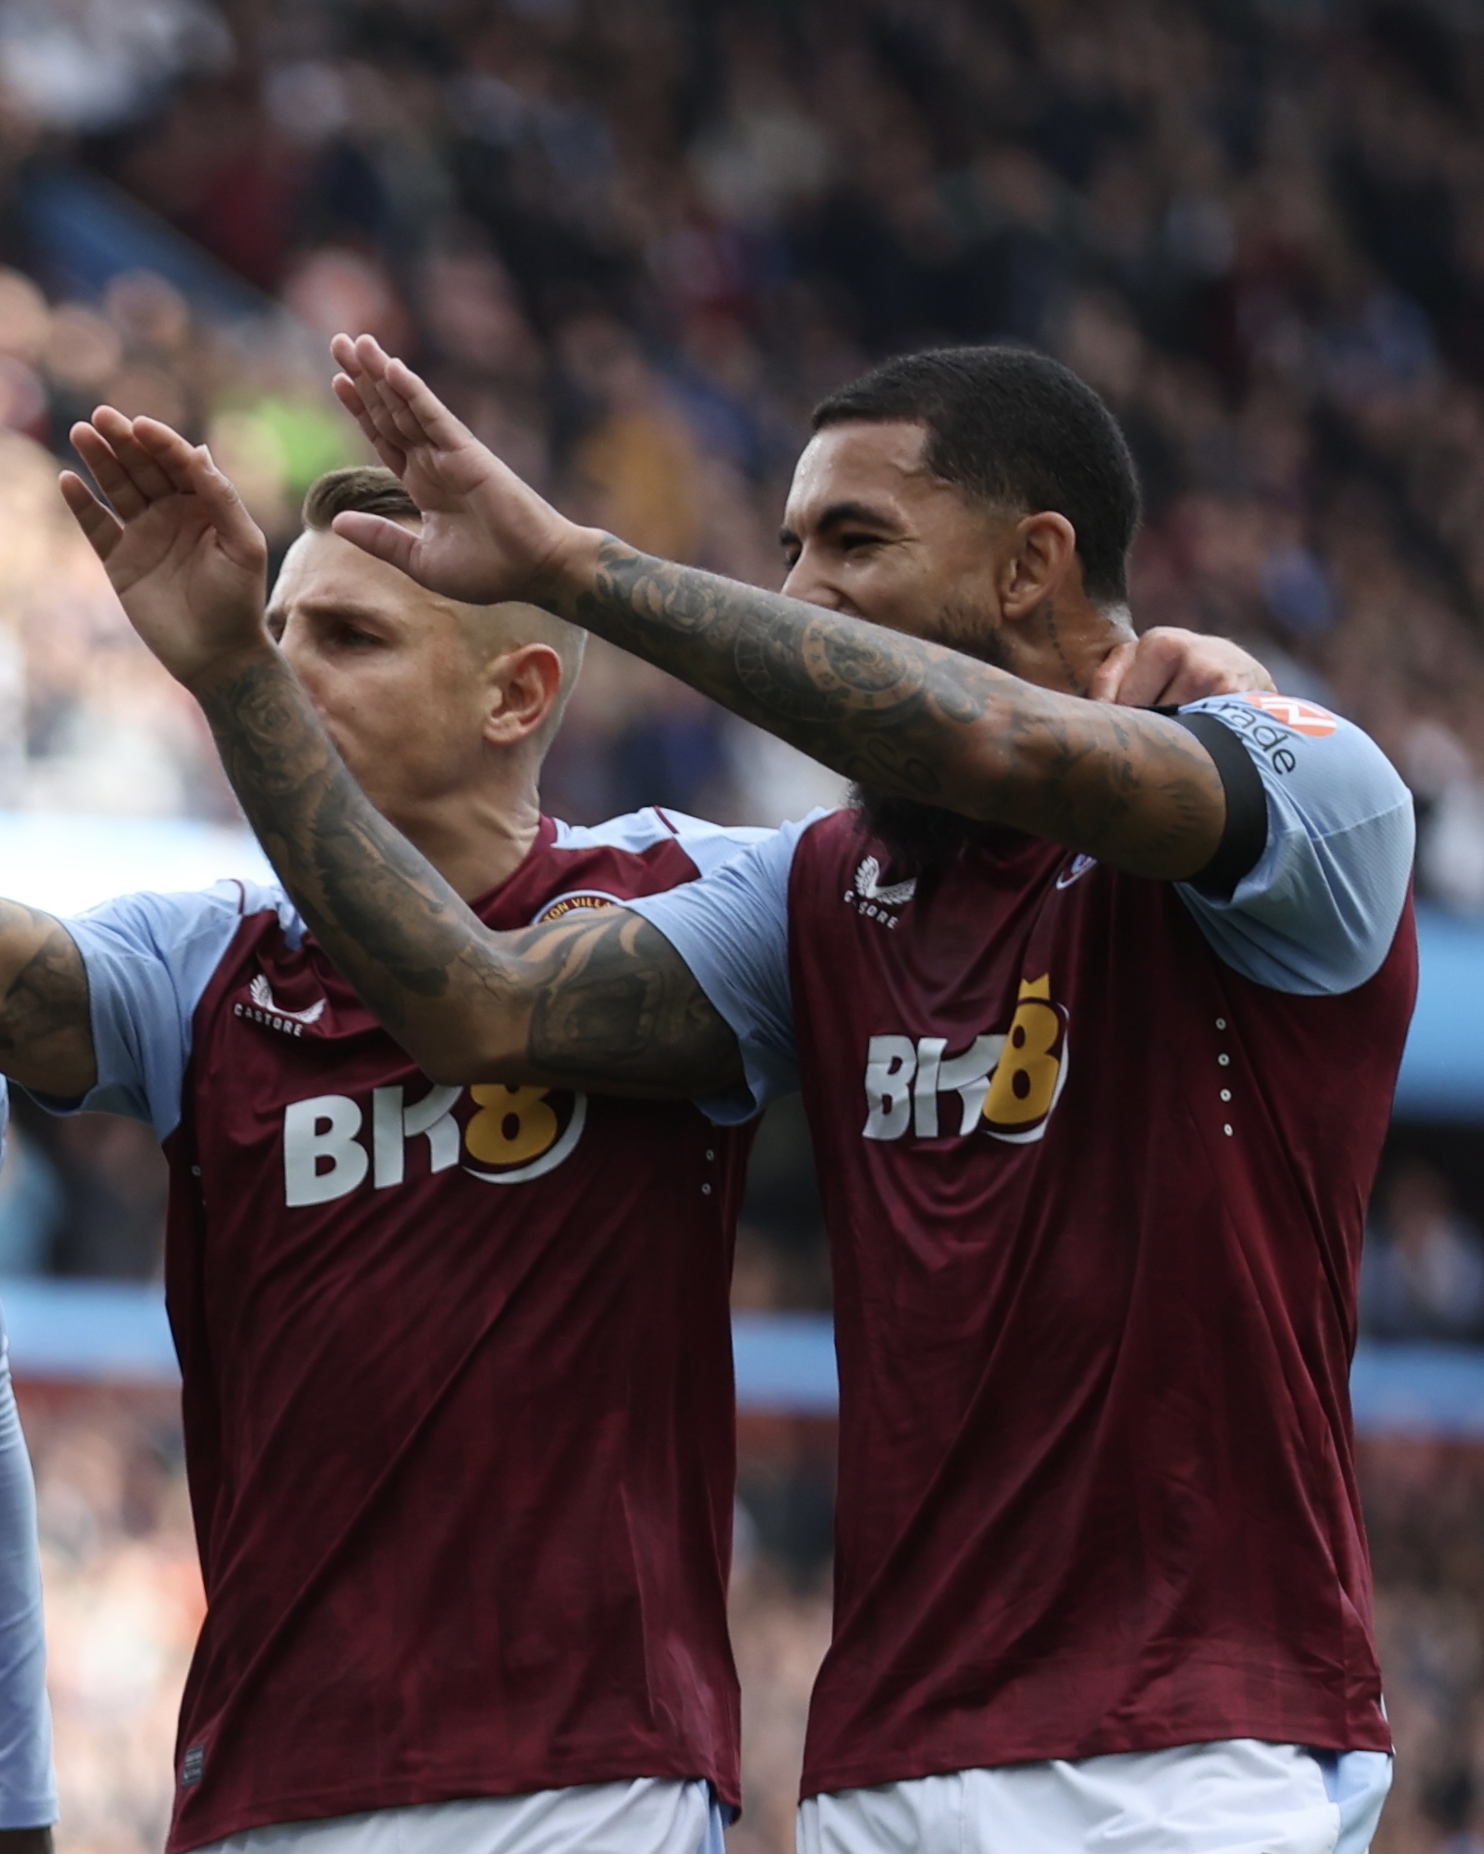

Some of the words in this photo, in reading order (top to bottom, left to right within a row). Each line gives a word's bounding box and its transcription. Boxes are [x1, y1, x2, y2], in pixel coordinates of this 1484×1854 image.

[234, 1003, 303, 1037] CASTORE
[861, 1002, 1061, 1141] BK8
[283, 1083, 558, 1208] BK8
